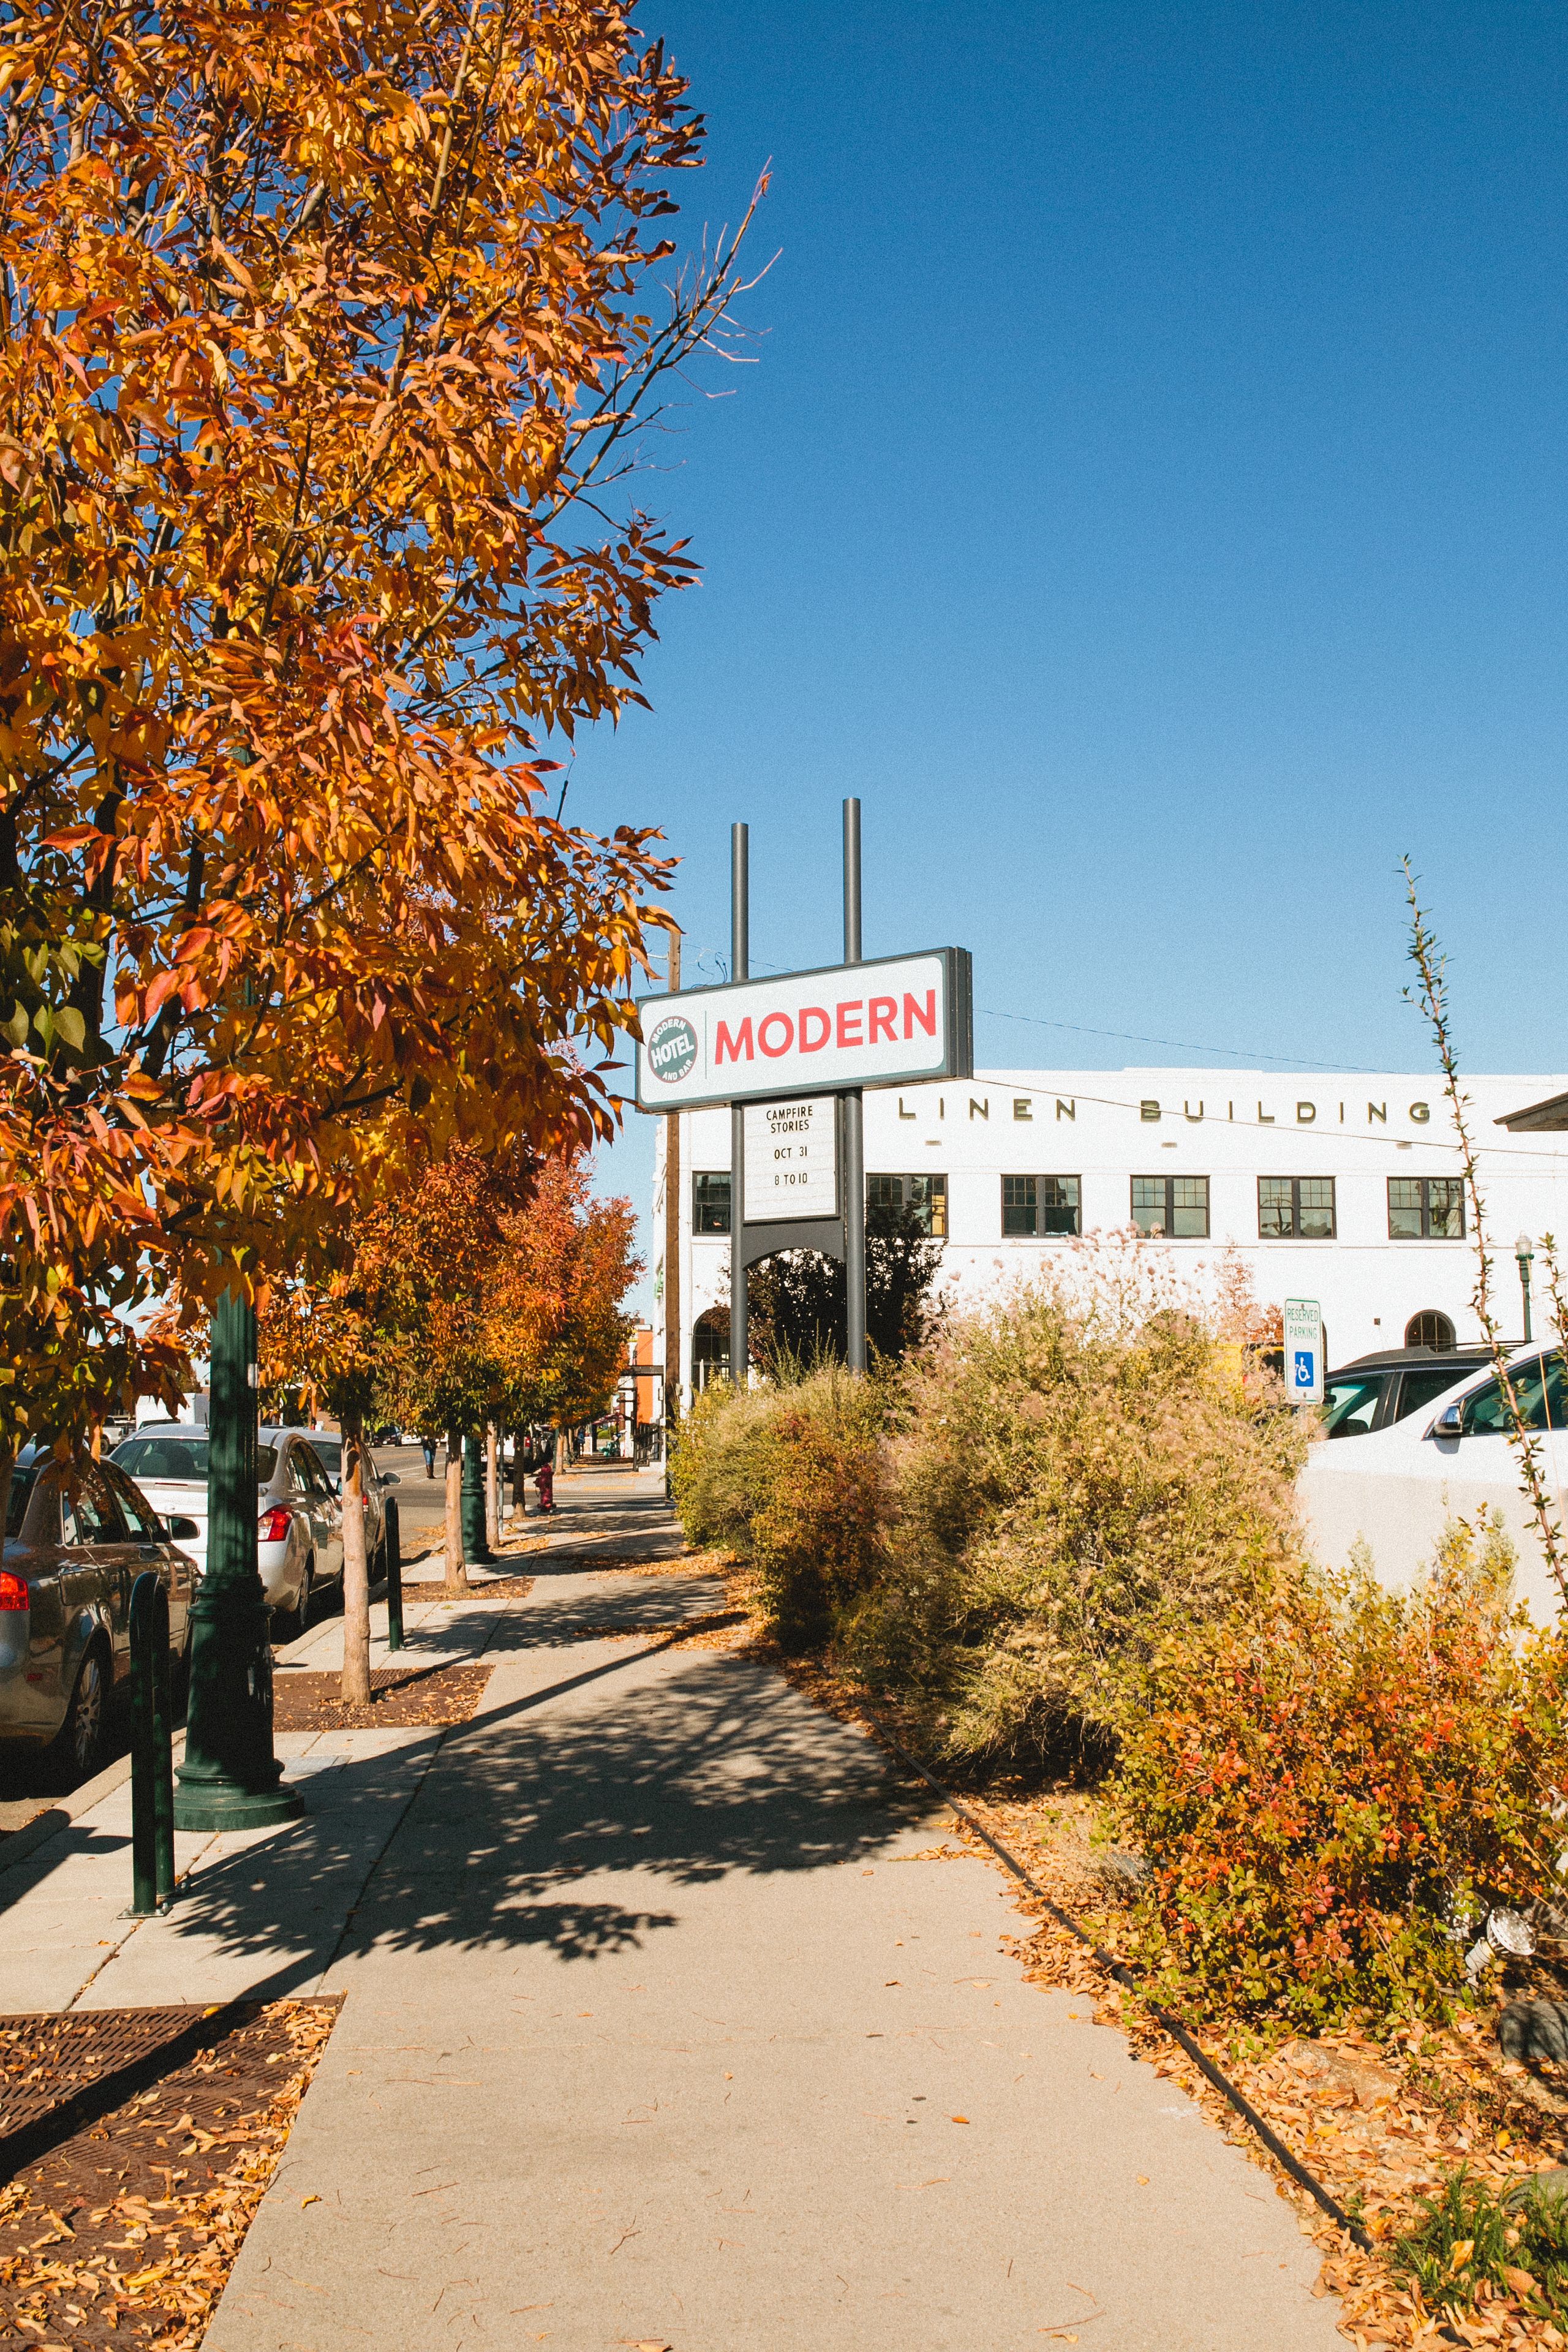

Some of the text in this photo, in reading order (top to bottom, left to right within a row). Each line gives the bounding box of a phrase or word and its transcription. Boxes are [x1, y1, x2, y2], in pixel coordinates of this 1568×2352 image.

[652, 1019, 686, 1044] MODERN
[715, 989, 936, 1065] MODERN
[650, 1033, 695, 1069] HOTEL
[662, 1059, 693, 1080] AND BAR
[766, 1106, 813, 1120] CAMPFIRE
[899, 1098, 1430, 1125] LINEN BUILDING
[771, 1120, 809, 1133] STORIES
[774, 1146, 807, 1159] OCT 31
[775, 1173, 807, 1185] 8 TO 10
[1287, 1308, 1318, 1322] RESERVED
[1289, 1326, 1317, 1340] PARKING
